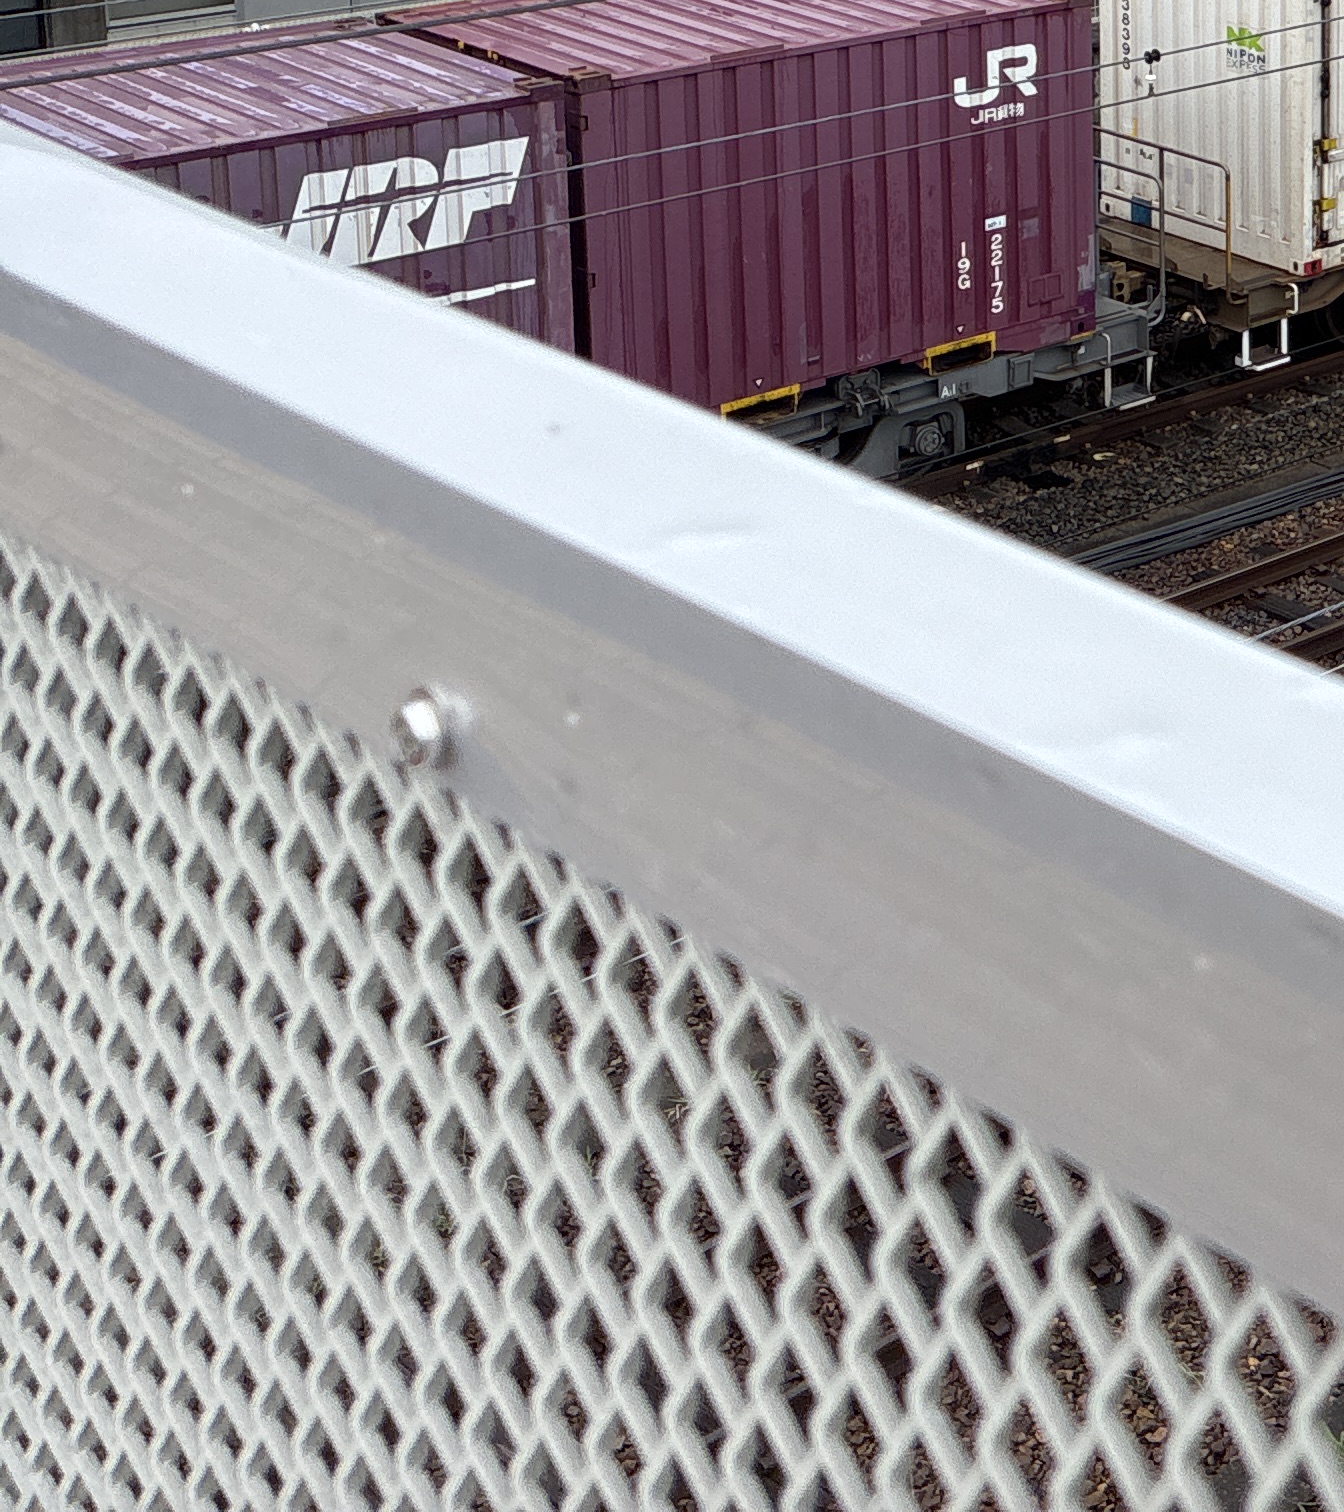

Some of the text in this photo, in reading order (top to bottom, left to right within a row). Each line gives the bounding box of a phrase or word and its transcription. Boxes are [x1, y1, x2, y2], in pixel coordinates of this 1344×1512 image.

[954, 43, 1038, 108] JR
[957, 241, 971, 289] 19G
[990, 233, 1004, 313] 22175
